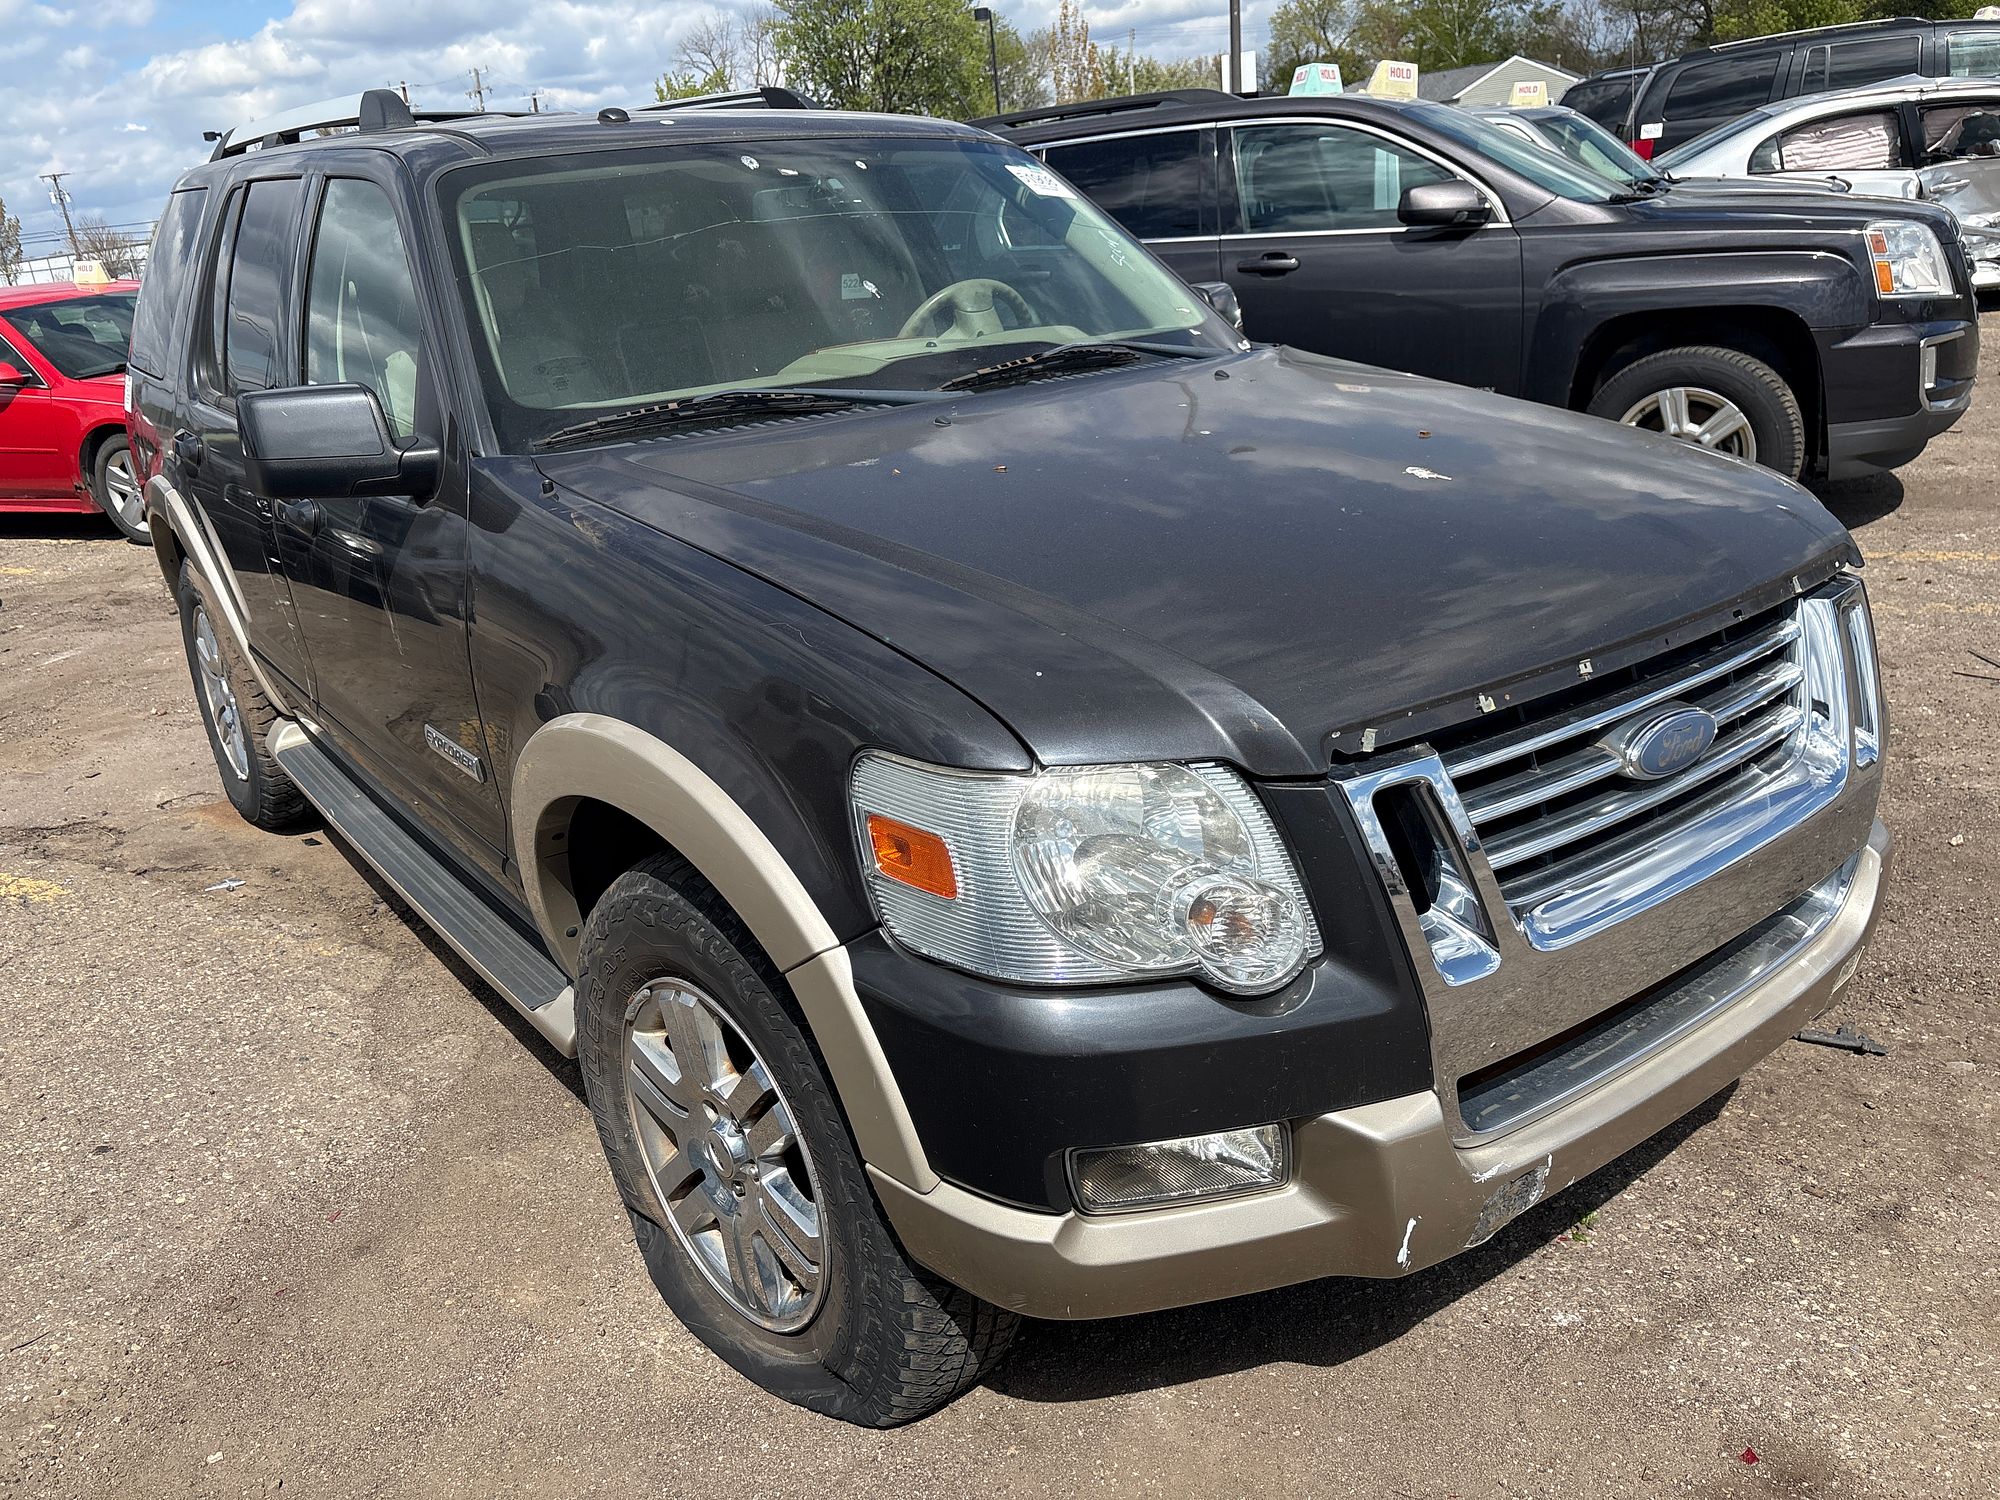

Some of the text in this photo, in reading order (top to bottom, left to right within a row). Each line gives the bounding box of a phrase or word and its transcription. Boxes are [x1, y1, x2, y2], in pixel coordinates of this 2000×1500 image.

[1390, 67, 1412, 79] HOLD
[1518, 86, 1538, 94] HOLD
[77, 264, 93, 272] HOLD
[426, 729, 477, 773] EXPLORER
[1657, 723, 1705, 768] Ford
